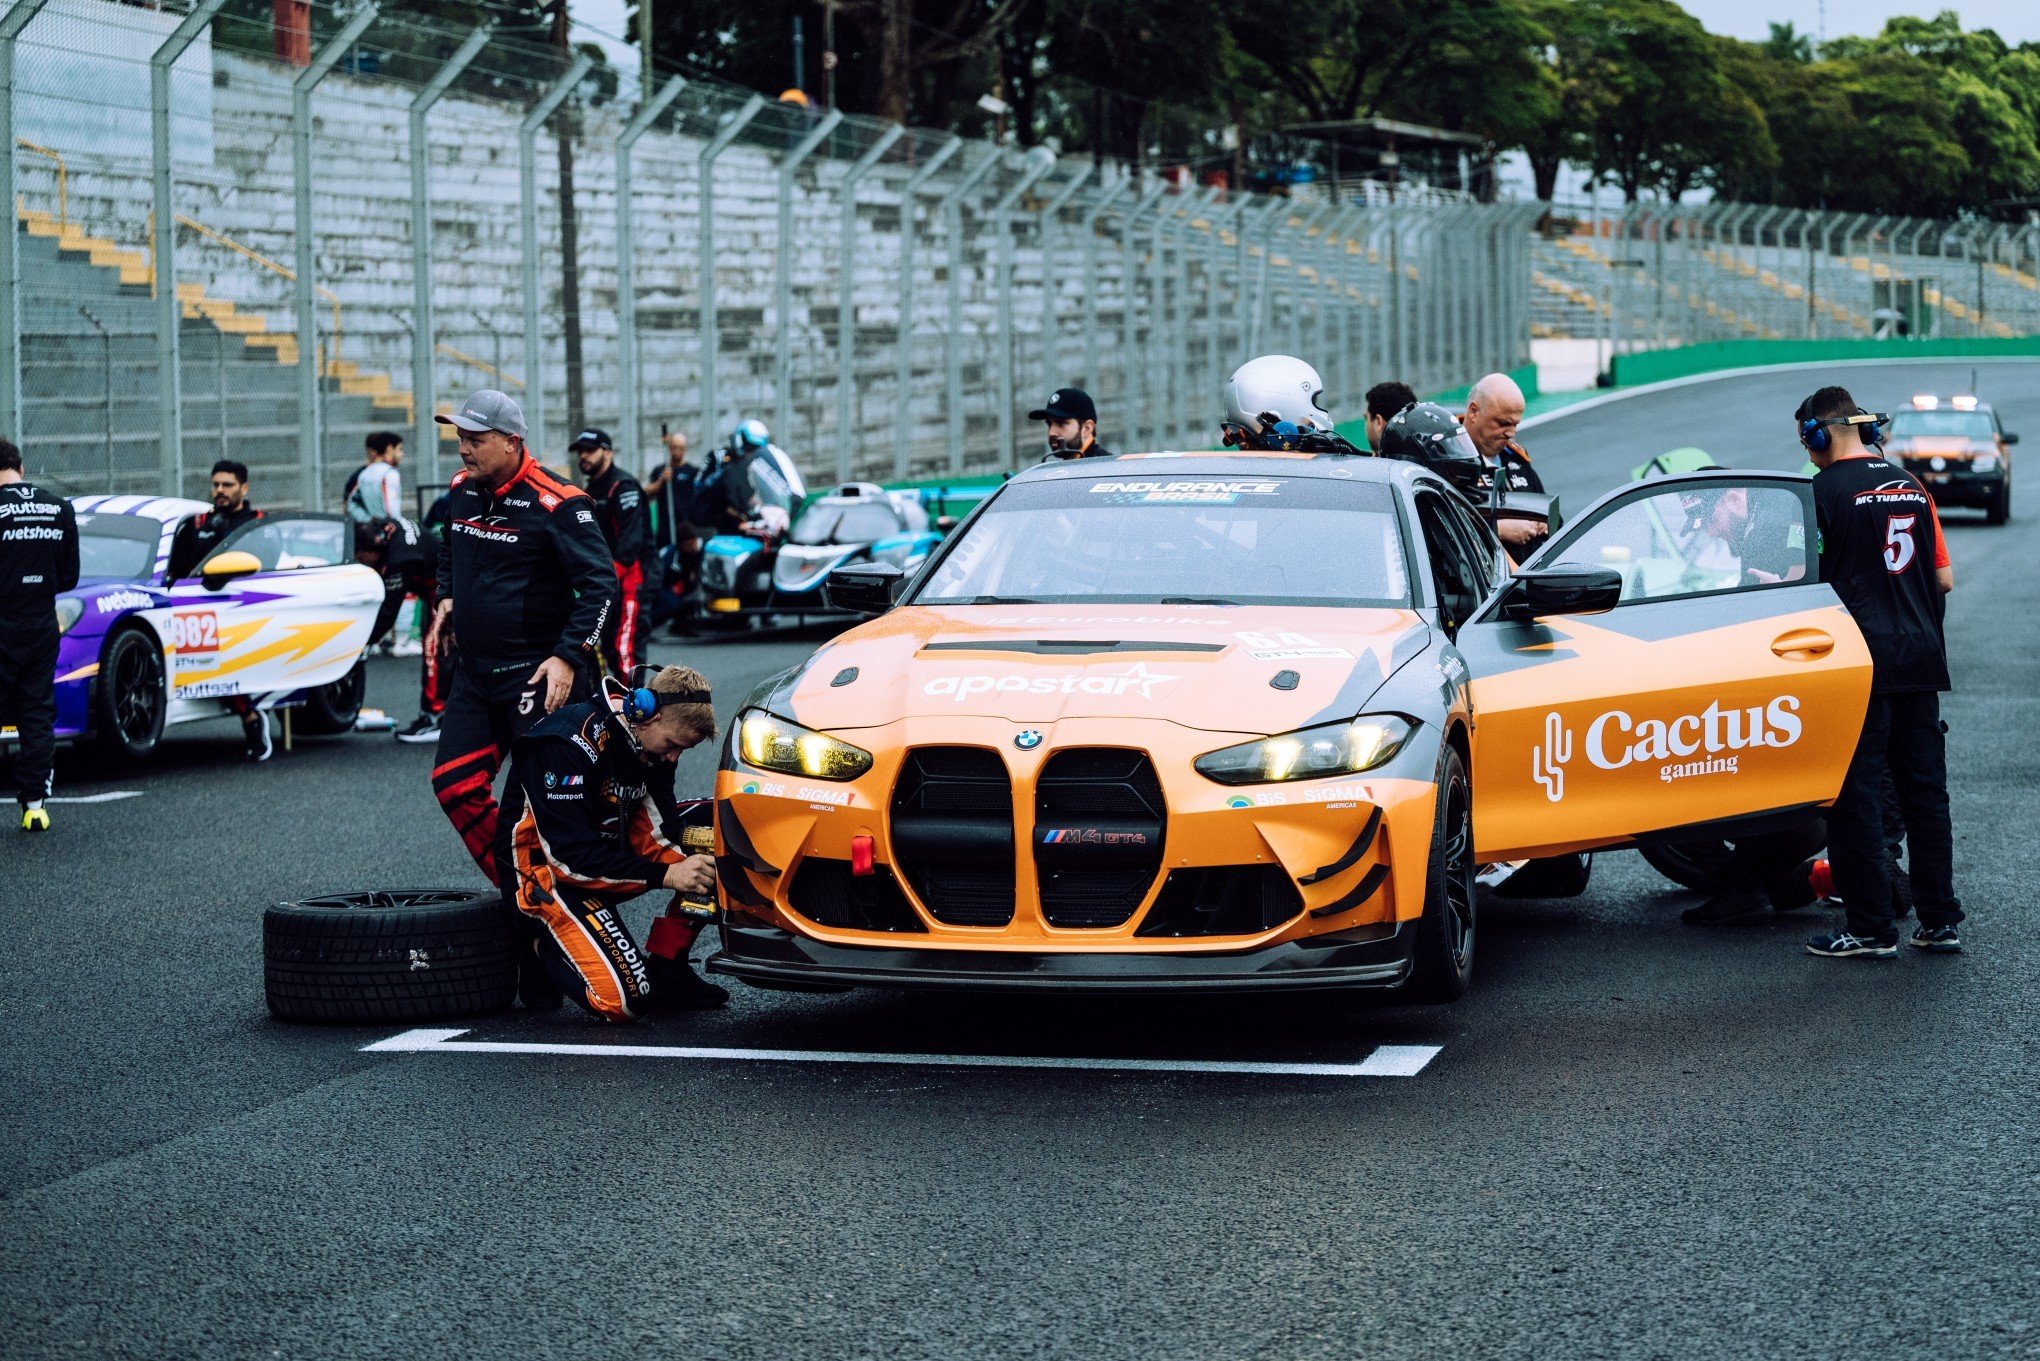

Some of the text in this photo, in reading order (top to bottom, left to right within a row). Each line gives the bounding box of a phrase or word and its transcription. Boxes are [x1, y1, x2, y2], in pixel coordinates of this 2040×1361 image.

[1089, 482, 1281, 493] ENDURANCE
[1143, 492, 1231, 501] BRASIL
[1855, 495, 1873, 505] MC
[511, 498, 531, 508] HUPI
[1883, 514, 1916, 574] 5
[175, 614, 218, 648] 982
[586, 599, 612, 646] Eurobike
[1021, 615, 1231, 625] Eurobike
[923, 668, 1160, 702] apostar
[518, 690, 536, 715] 5
[1585, 693, 1803, 771] Cactus
[571, 733, 598, 763] sparco
[1660, 755, 1738, 783] gaming
[547, 792, 584, 801] Motorsport
[809, 803, 835, 813] AMERICAS
[1326, 802, 1357, 810] AMERICAS
[1104, 832, 1146, 844] GT4
[594, 908, 650, 995] Eurobike
[598, 929, 639, 998] MOTORSPORT
